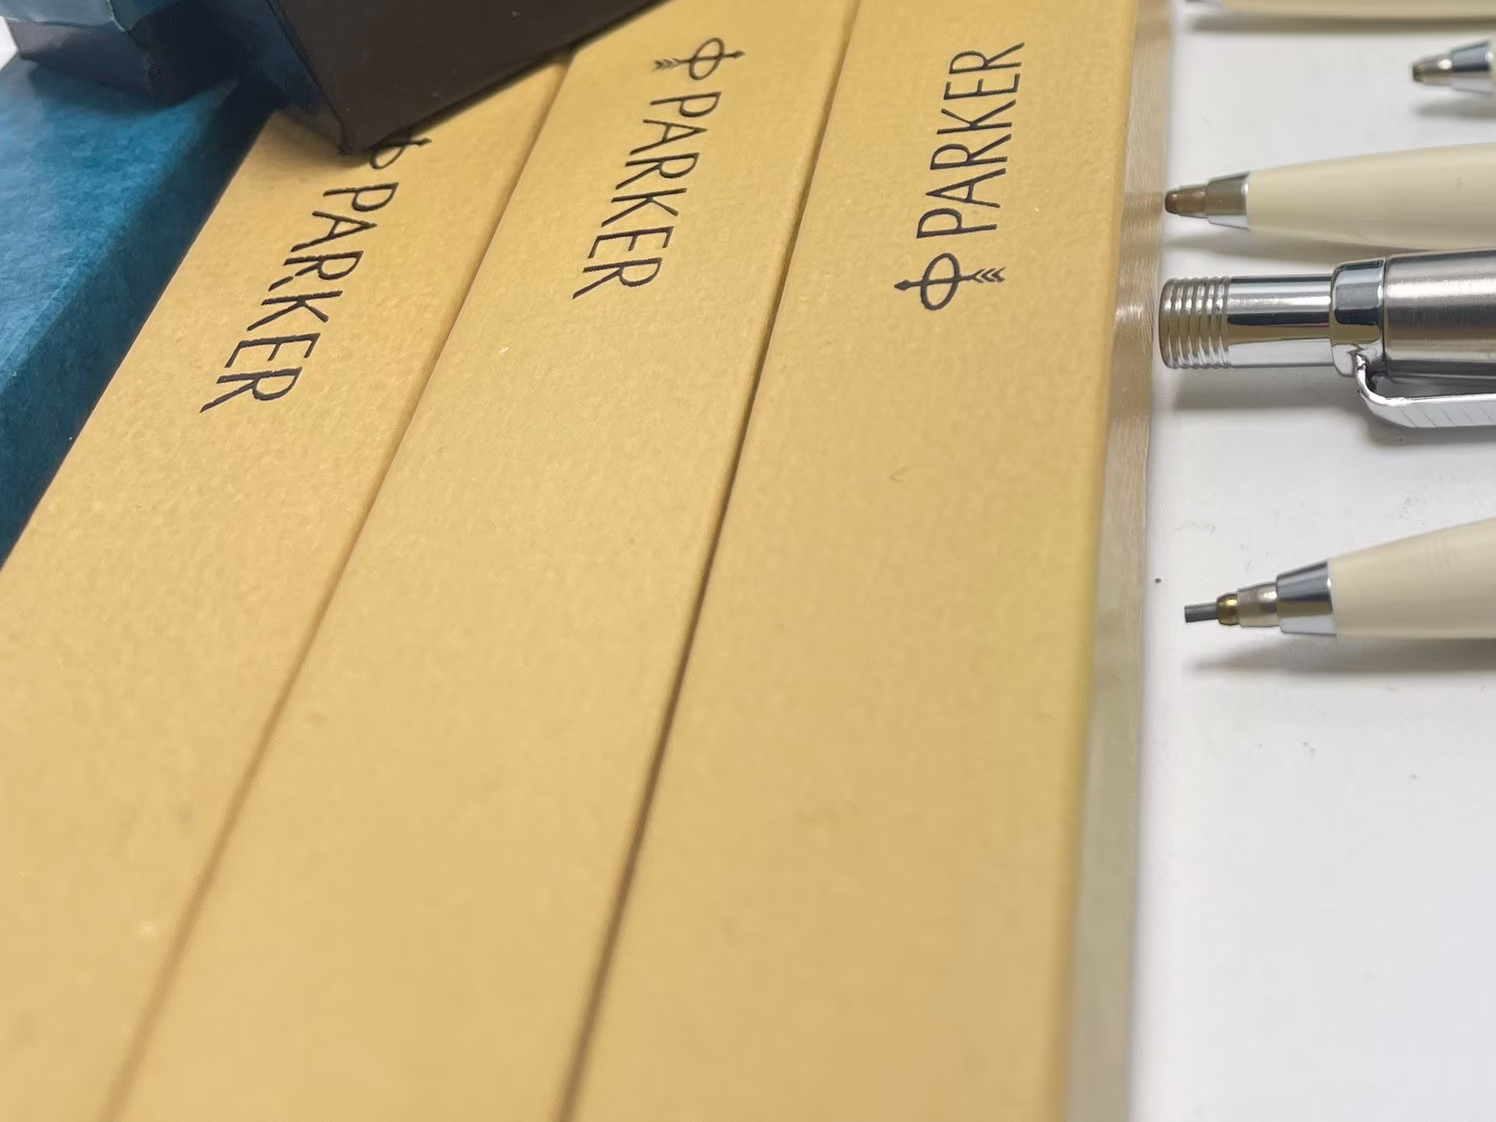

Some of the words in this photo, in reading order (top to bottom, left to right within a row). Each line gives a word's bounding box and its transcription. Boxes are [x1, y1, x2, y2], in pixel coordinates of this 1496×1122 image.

[571, 90, 724, 300] PARKER
[915, 41, 1026, 241] PARKER
[199, 180, 400, 414] PARKER
